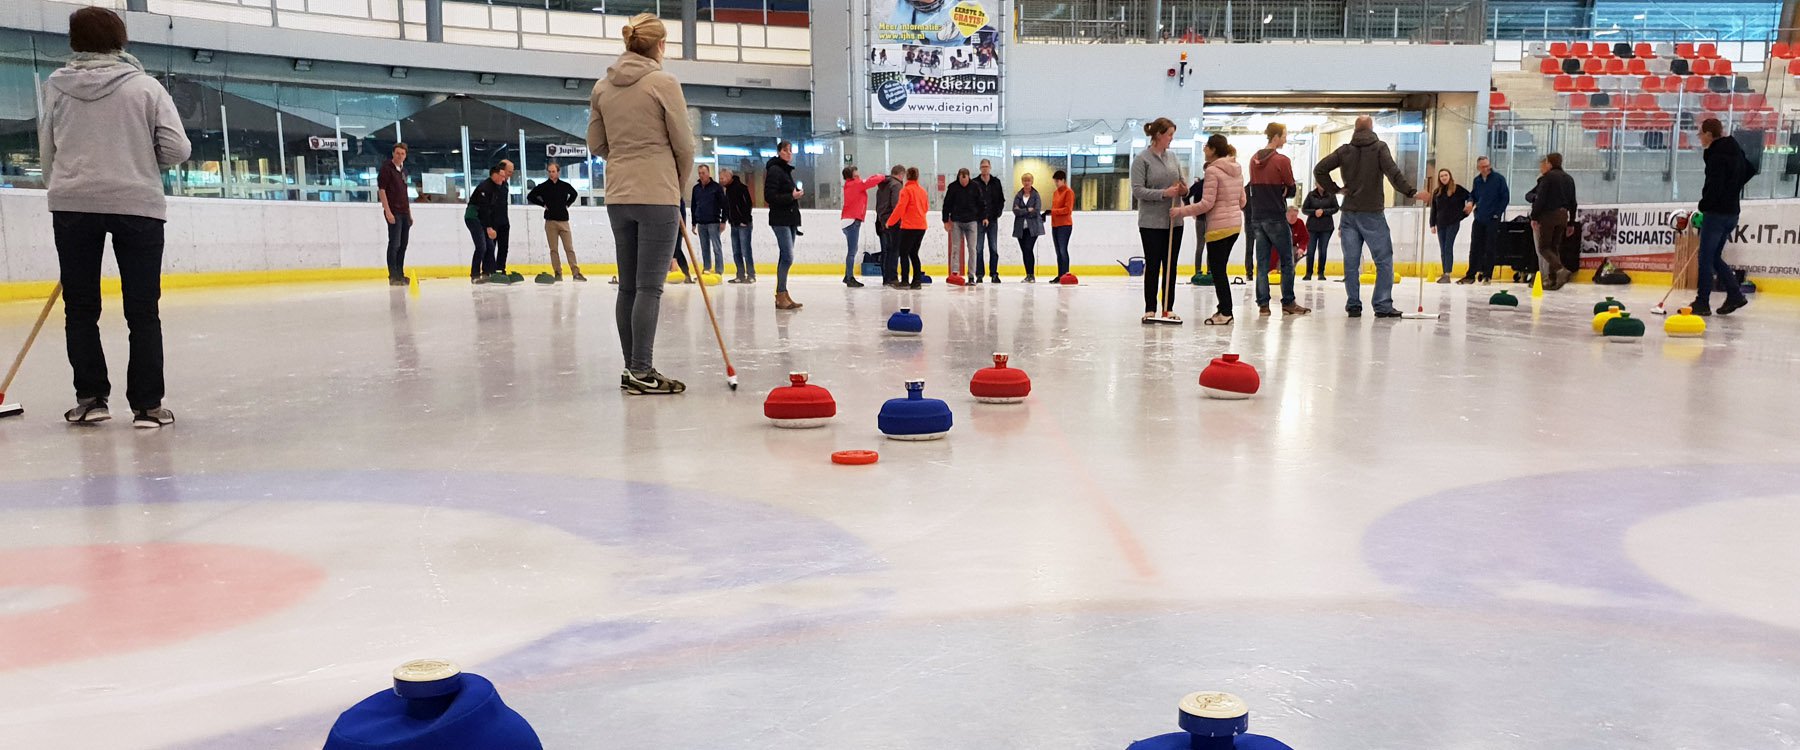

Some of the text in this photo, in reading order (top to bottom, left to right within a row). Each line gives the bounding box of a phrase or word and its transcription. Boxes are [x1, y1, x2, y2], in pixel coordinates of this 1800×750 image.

[953, 13, 984, 25] GRATIS!
[879, 22, 897, 31] Meer
[940, 76, 995, 93] diezign
[907, 102, 993, 114] www.diezign.nl
[558, 146, 585, 154] Jupiler
[1619, 212, 1640, 226] WIL
[1641, 211, 1656, 226] JIJ
